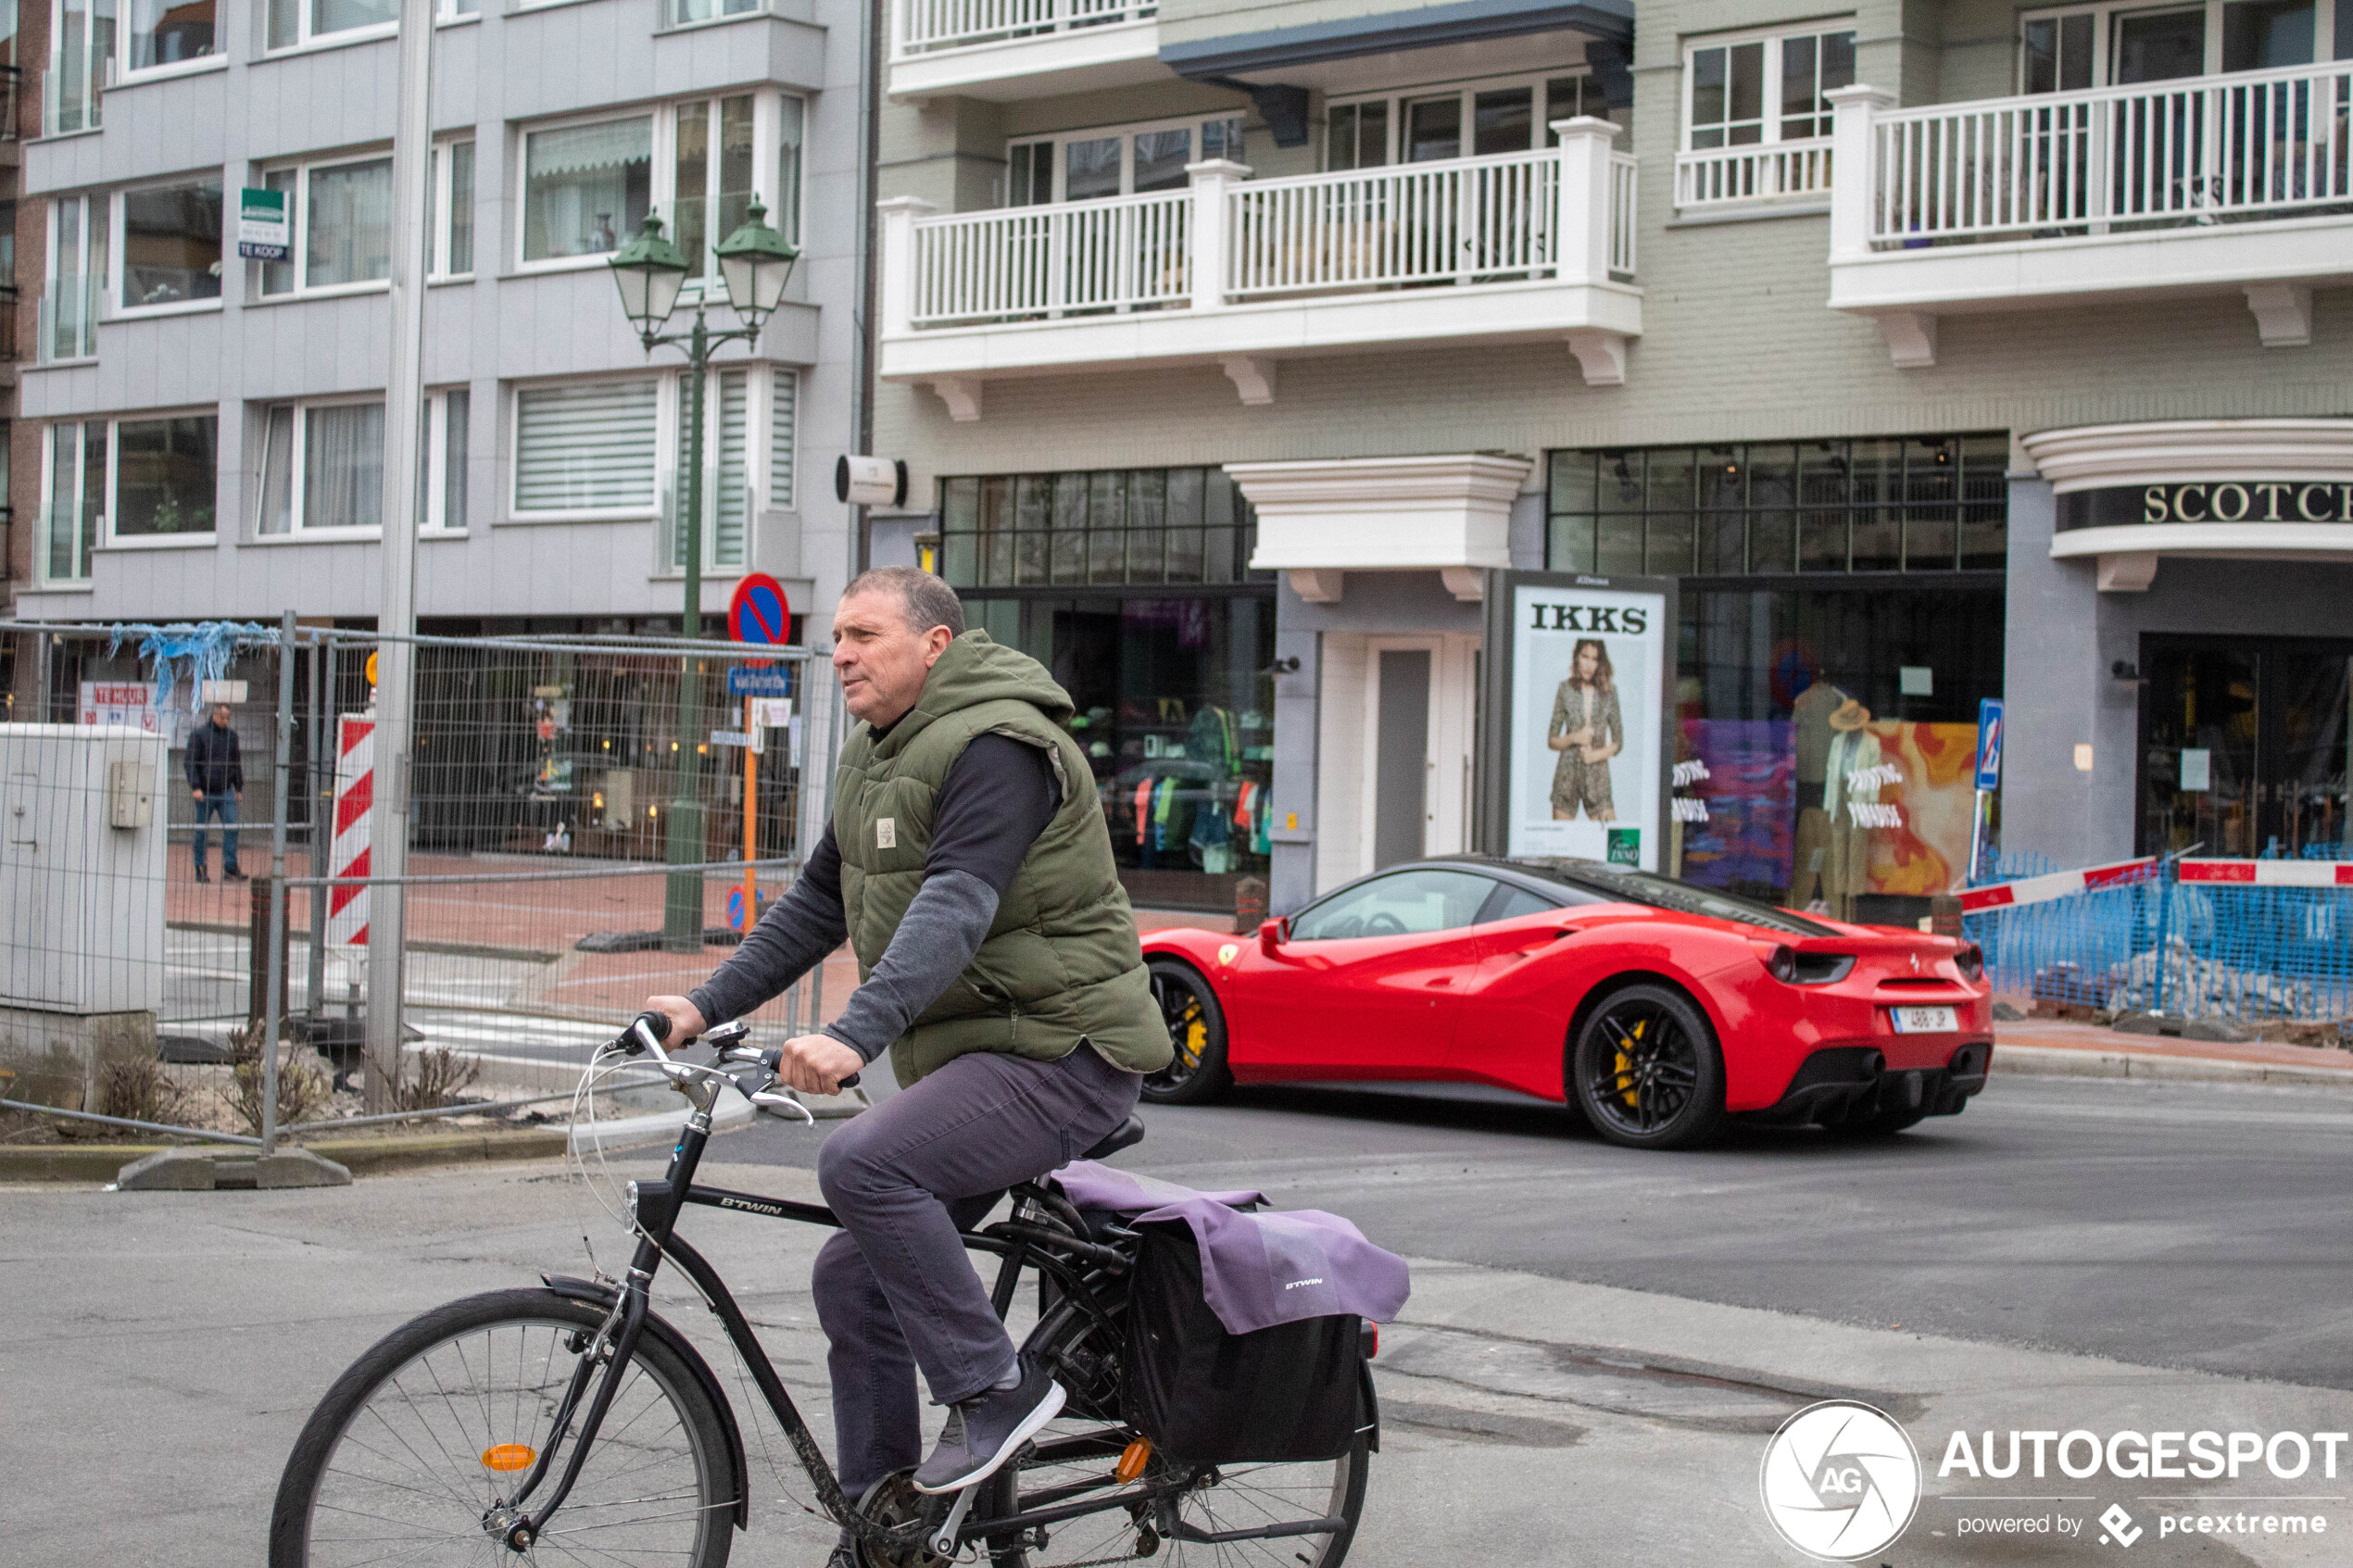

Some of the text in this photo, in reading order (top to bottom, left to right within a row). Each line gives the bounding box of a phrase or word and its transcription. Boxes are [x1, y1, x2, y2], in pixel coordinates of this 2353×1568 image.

[241, 243, 283, 258] TE KOOP
[1530, 603, 1647, 634] IKKS
